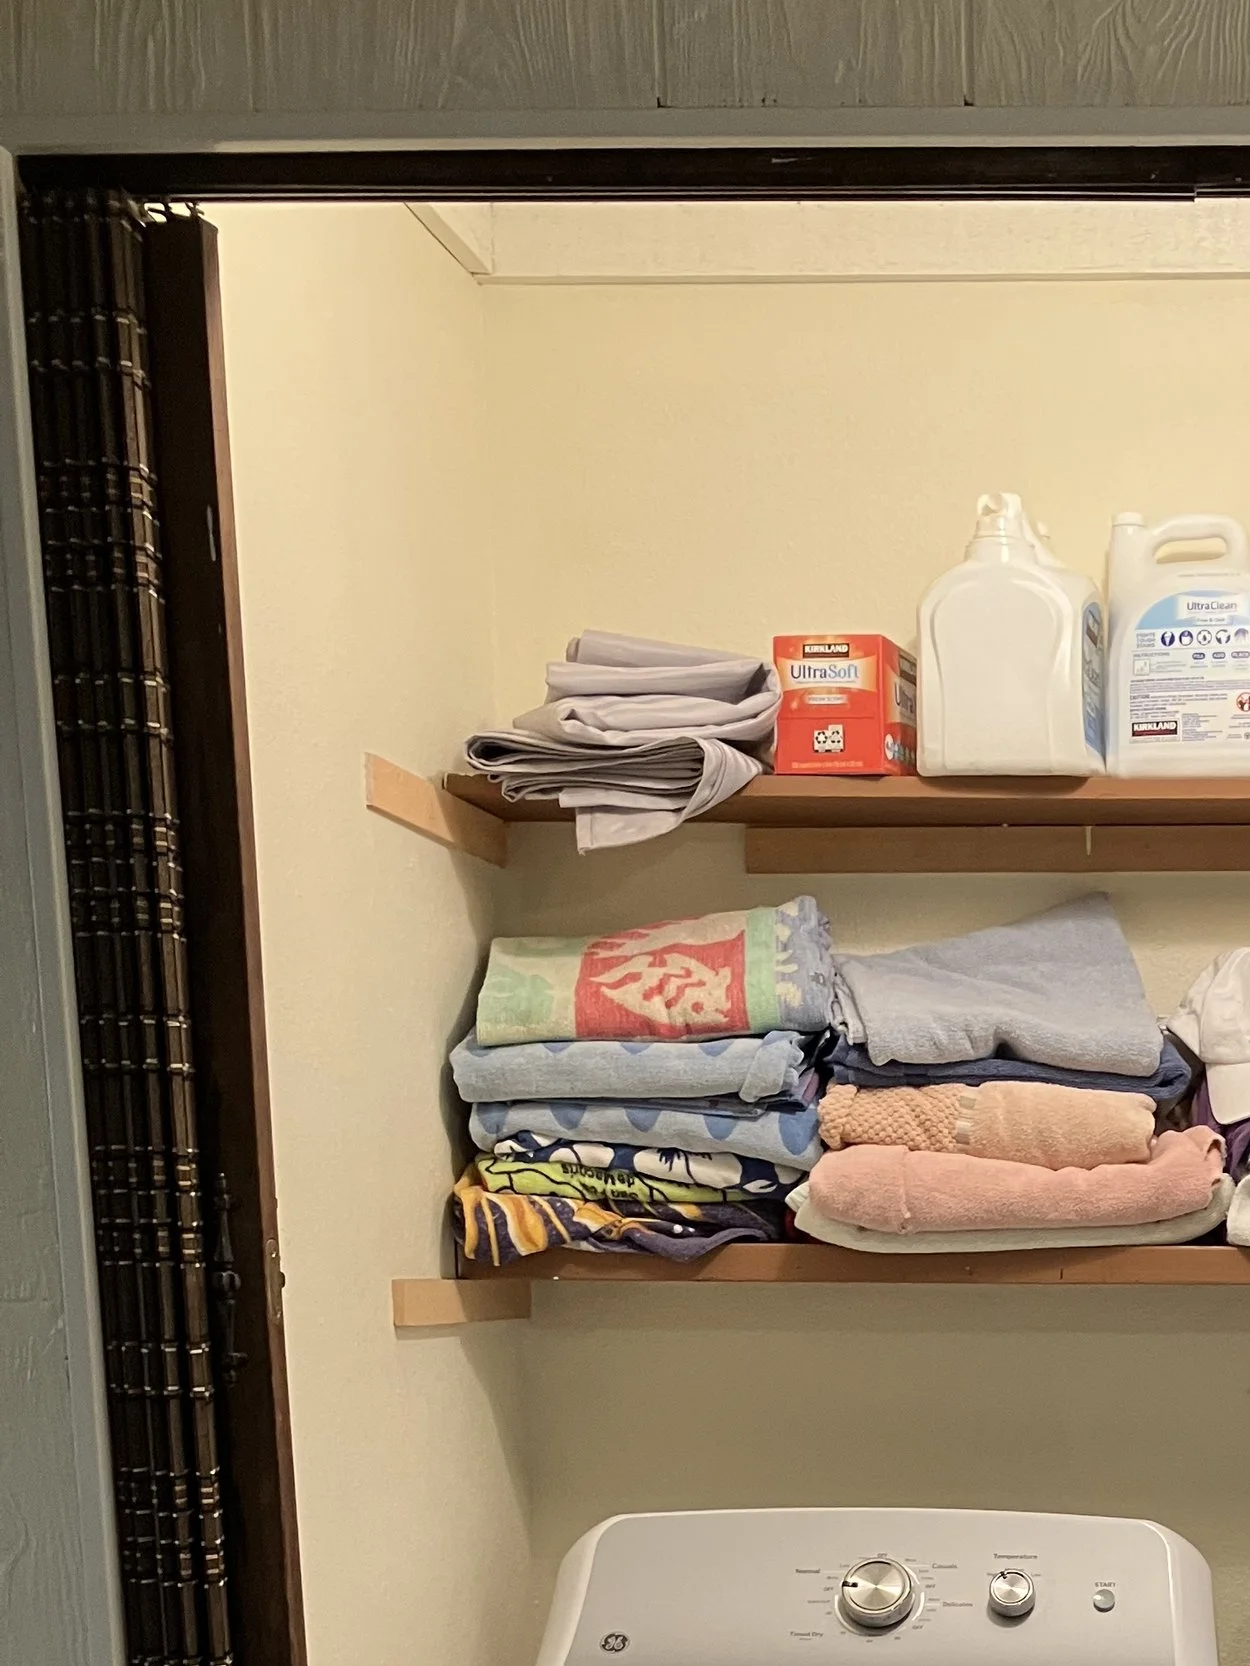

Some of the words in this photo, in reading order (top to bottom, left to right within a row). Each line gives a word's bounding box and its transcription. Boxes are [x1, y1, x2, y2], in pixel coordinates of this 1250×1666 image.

[804, 644, 848, 653] KIRKLAND
[790, 664, 858, 680] UltraSoft
[1133, 721, 1177, 731] KIRKLAND
